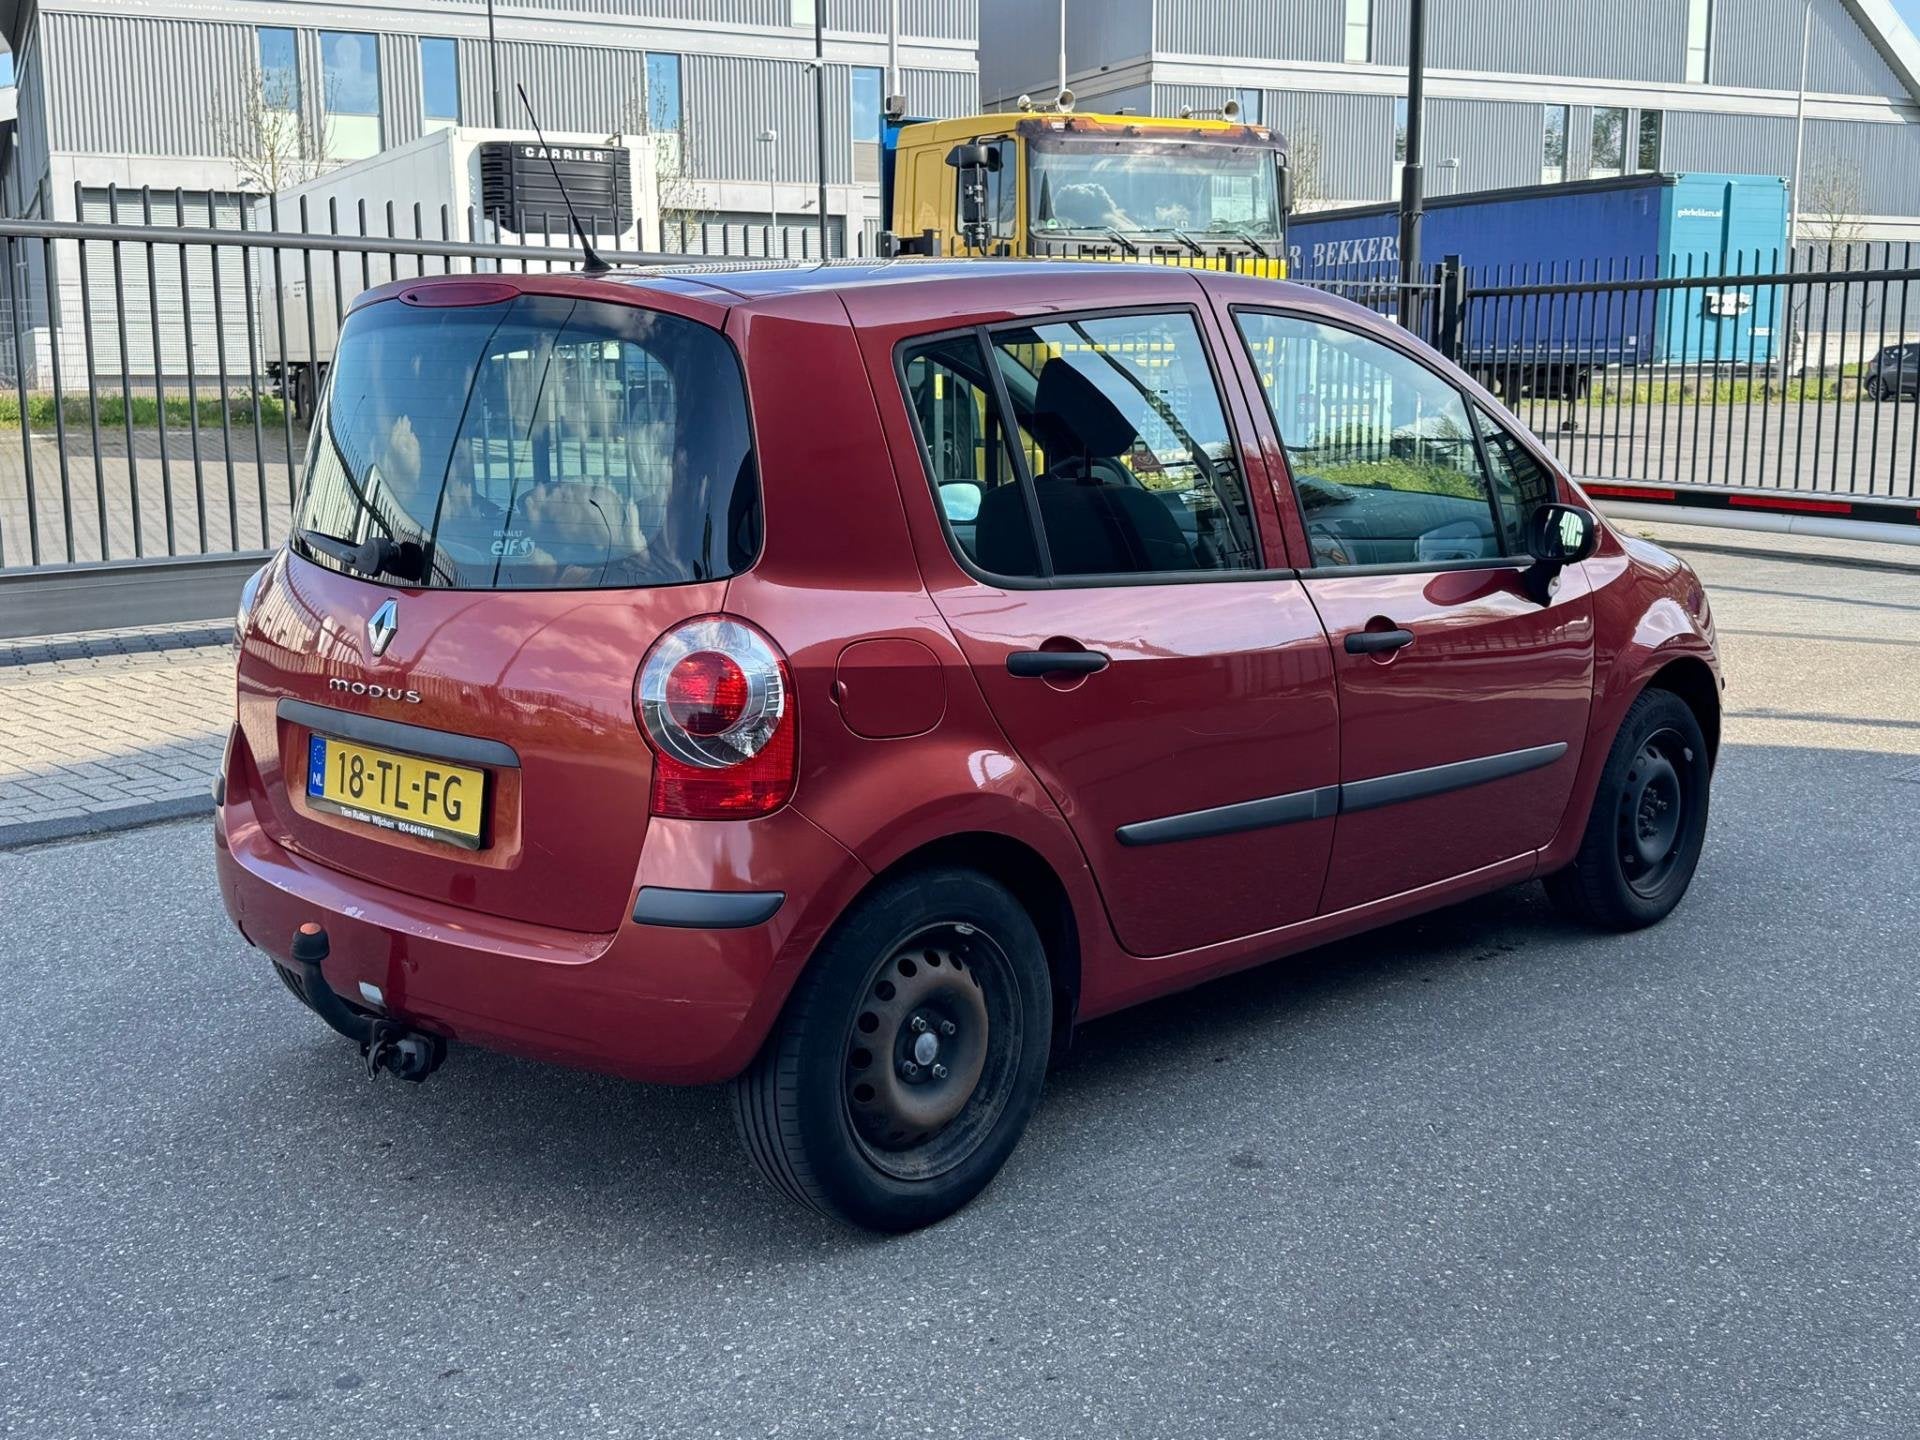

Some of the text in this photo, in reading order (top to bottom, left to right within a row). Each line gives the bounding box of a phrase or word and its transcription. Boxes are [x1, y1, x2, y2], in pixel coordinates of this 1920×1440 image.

[525, 147, 603, 161] CARRIER
[312, 771, 323, 787] NL
[338, 751, 462, 822] 18-TL-FG
